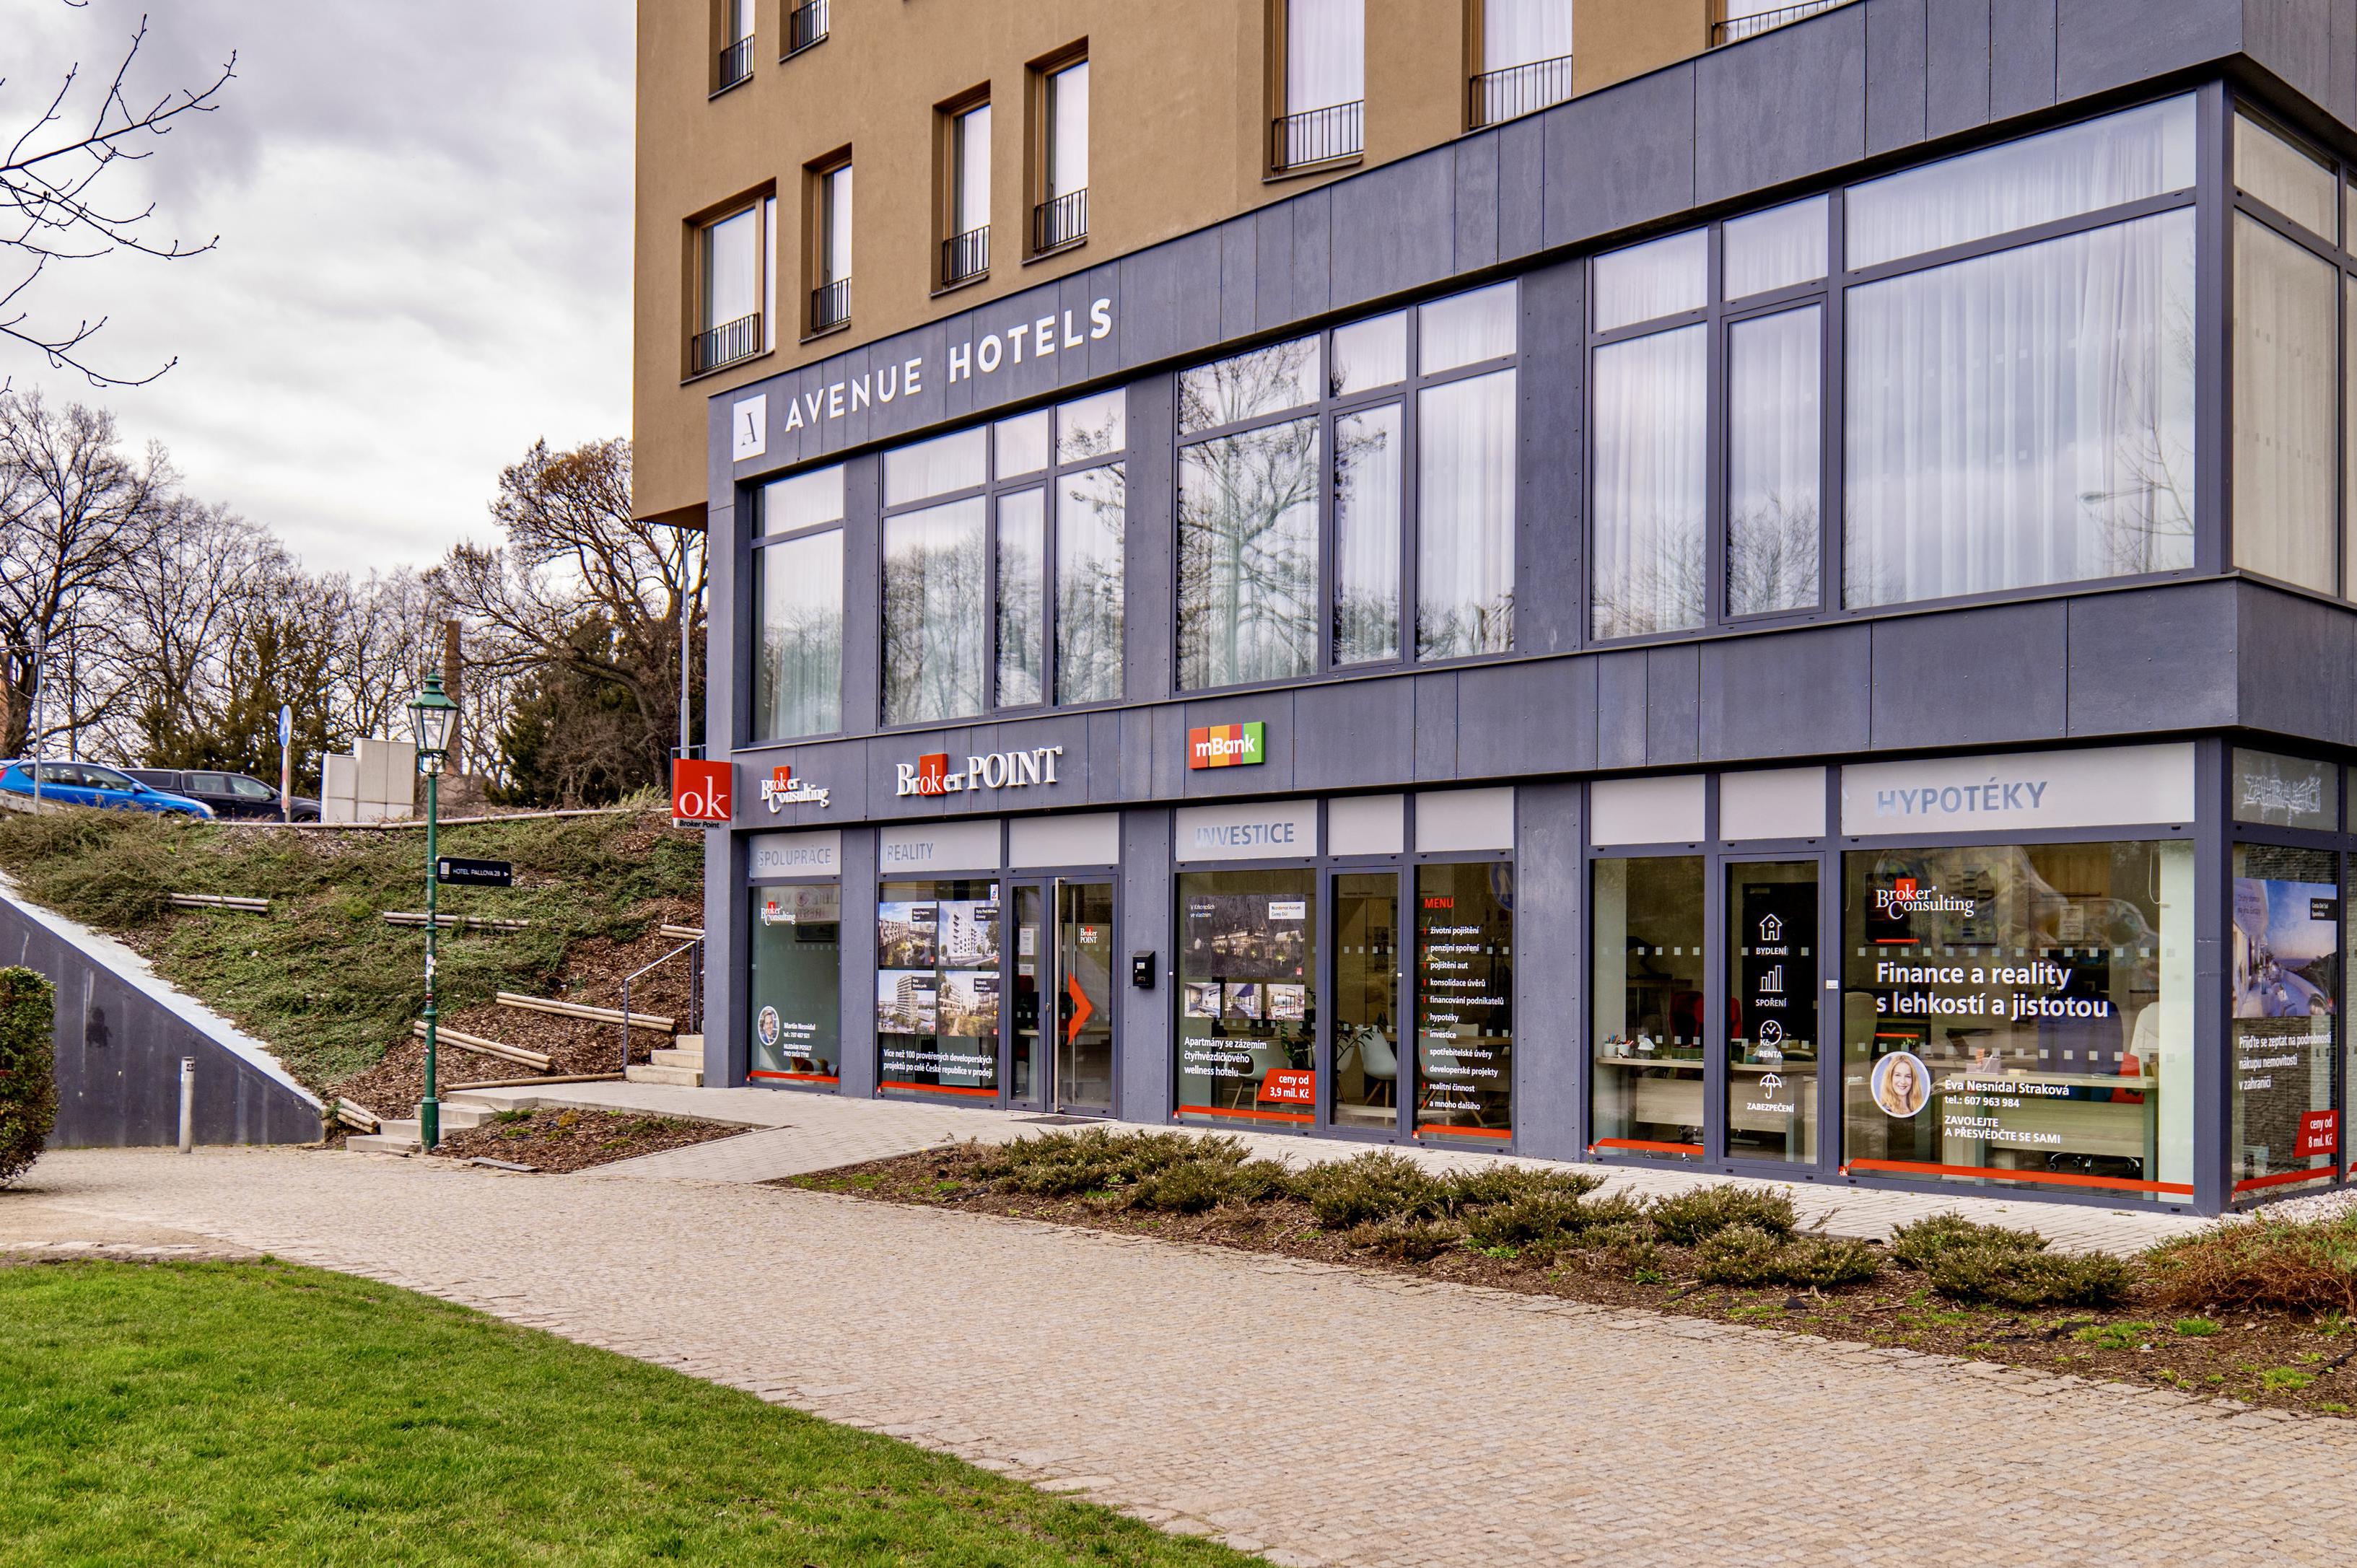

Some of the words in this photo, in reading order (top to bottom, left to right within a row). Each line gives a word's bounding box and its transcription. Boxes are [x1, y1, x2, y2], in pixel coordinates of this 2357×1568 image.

[784, 356, 922, 433] AVENUE
[948, 297, 1112, 383] HOTELS
[740, 412, 757, 446] A
[1196, 733, 1255, 758] mBank
[896, 763, 966, 795] Broker
[967, 745, 1063, 789] POINT
[761, 773, 800, 800] Broker
[679, 776, 729, 818] ok
[769, 783, 830, 813] Consulting
[1878, 777, 2047, 815] HYPOTÉKY
[1197, 822, 1294, 848] INVESTICE
[758, 844, 831, 867] SPOLUPRÁCE
[887, 843, 934, 861] REALITY
[1424, 898, 1453, 908] MENU
[1876, 884, 1931, 908] Broker
[761, 905, 781, 919] Broker
[1888, 895, 1975, 919] Consulting
[765, 911, 795, 926] Consulting
[1080, 927, 1097, 937] Broker
[1453, 927, 1479, 935] pojištění
[1430, 944, 1455, 952] penzijní
[1456, 944, 1479, 952] spoření
[1756, 945, 1788, 955] BYDLENÍ
[1876, 962, 1964, 983] Finance
[1971, 968, 1984, 983] a
[1991, 962, 2072, 990] reality
[1430, 996, 1466, 1004] financování
[1466, 997, 1504, 1006] podnikatelů
[1756, 997, 1787, 1007] SPOŘENÍ
[1876, 997, 1886, 1012] s
[1893, 991, 1985, 1015] lehkostí
[1991, 999, 2005, 1015] a
[2011, 993, 2109, 1021] jistotou
[1430, 1013, 1459, 1022] hypotéky
[1184, 1036, 1223, 1050] Apartmány
[1235, 1040, 1267, 1049] zázemím
[2261, 1038, 2268, 1047] se
[2269, 1035, 2287, 1049] zeptat
[2288, 1036, 2295, 1046] na
[2297, 1031, 2331, 1048] podrobnosti
[916, 1051, 949, 1061] prověřených
[950, 1054, 992, 1065] developerských
[1184, 1051, 1249, 1064] čtyřhvězdičkového
[1430, 1048, 1473, 1057] spotřebitelské
[1474, 1050, 1492, 1059] úvěry
[1759, 1050, 1783, 1059] RENTA
[2239, 1056, 2261, 1071] nákupu
[2262, 1054, 2297, 1067] nemovitosti
[883, 1062, 905, 1072] projektů
[926, 1063, 941, 1073] České
[943, 1066, 967, 1075] republice
[973, 1068, 992, 1079] prodeji
[1184, 1065, 1215, 1075] wellness
[1215, 1066, 1238, 1077] hotelu
[1430, 1065, 1470, 1074] developerské
[1472, 1067, 1498, 1077] projekty
[1279, 1076, 1296, 1086] ceny
[1299, 1075, 1308, 1085] od
[1453, 1083, 1475, 1092] činnost
[1945, 1079, 1964, 1091] Eva
[1967, 1080, 2016, 1093] Nesnídal
[2019, 1083, 2070, 1096] Straková
[2239, 1081, 2243, 1090] v
[2244, 1075, 2271, 1090] zahraničí
[1270, 1087, 1282, 1098] 3,9
[1283, 1087, 1297, 1098] mil.
[1300, 1089, 1309, 1098] Kč
[1458, 1101, 1480, 1110] dalšího
[1746, 1102, 1794, 1113] ZABEZPEČENÍ
[1945, 1095, 1962, 1105] tel.:
[1964, 1095, 1981, 1105] 607
[1983, 1096, 2000, 1106] 963
[2002, 1098, 2020, 1108] 984
[1944, 1115, 1998, 1127] ZAVOLEJTE
[2310, 1120, 2324, 1131] ceny
[2325, 1115, 2332, 1128] od
[1944, 1127, 1953, 1137] A
[1954, 1126, 2016, 1141] PŘESVĚDČTE
[2019, 1131, 2032, 1142] SE
[2034, 1132, 2061, 1144] SAMI
[2309, 1136, 2312, 1147] 8
[2314, 1134, 2324, 1147] mil.
[2325, 1133, 2332, 1145] Kč
